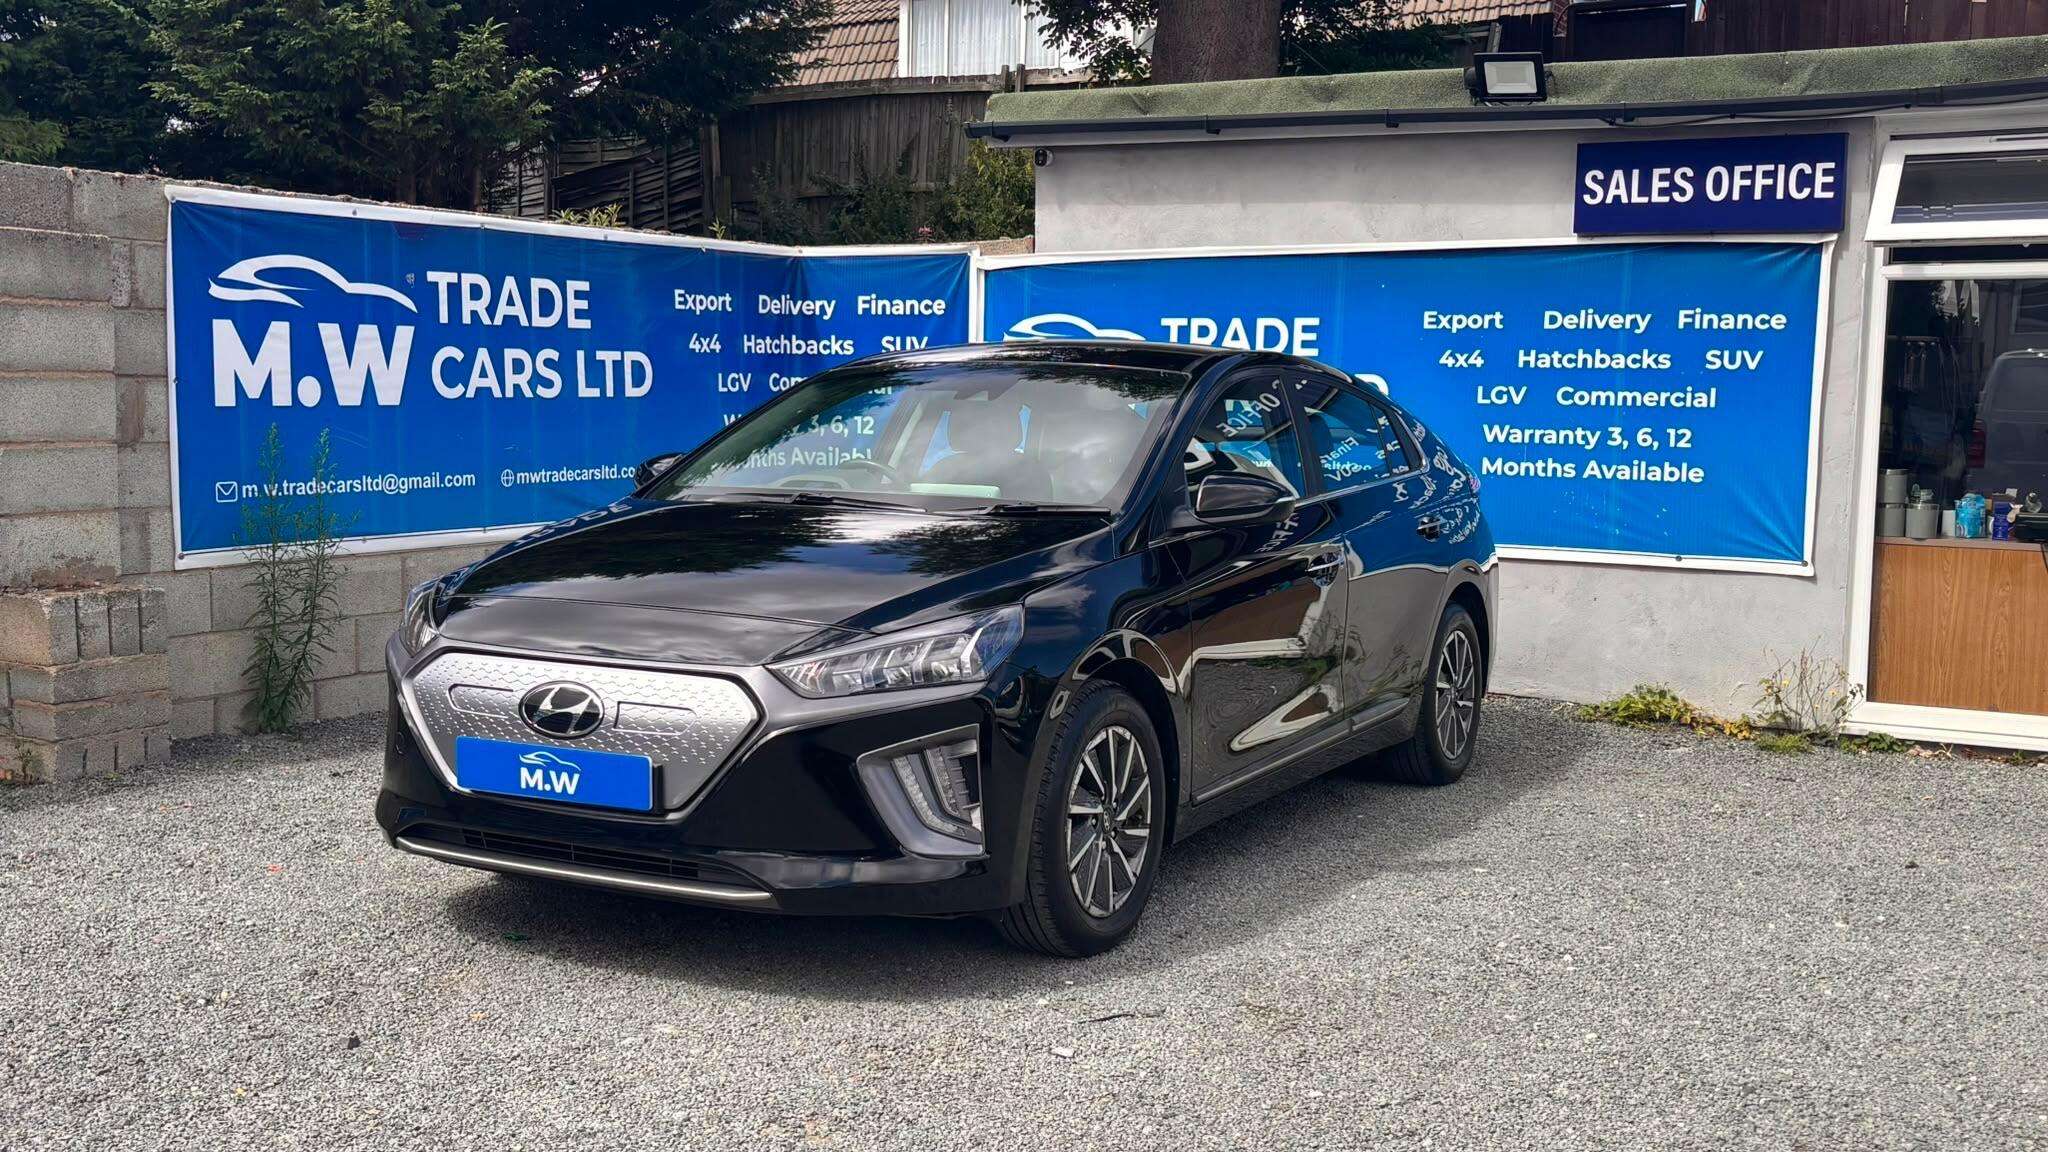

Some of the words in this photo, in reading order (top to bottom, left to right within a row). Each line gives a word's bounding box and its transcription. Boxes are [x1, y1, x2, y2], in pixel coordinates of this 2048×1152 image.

[1583, 167, 1694, 205] SALES
[1705, 162, 1836, 201] OFFICE
[426, 270, 592, 330] TRADE
[674, 289, 732, 315] Export
[758, 294, 836, 320] Delivery
[857, 293, 946, 316] Finance
[1423, 311, 1504, 333] Export
[1543, 308, 1651, 333] Delivery
[1678, 308, 1787, 330] Finance
[688, 333, 722, 354] 4x4
[743, 334, 855, 355] Hatchbacks
[881, 335, 928, 352] SUV
[1160, 317, 1320, 357] TRADE
[212, 318, 415, 408] M.W
[431, 345, 563, 399] CARS
[576, 350, 653, 398] LTD
[1438, 349, 1485, 368] 4x4
[1518, 348, 1672, 370] Hatchbacks
[1705, 350, 1764, 370] SUV
[718, 372, 752, 393] LGV
[1476, 385, 1527, 405] LGV
[1556, 386, 1717, 408] Commercial
[831, 416, 849, 437] 6,
[854, 416, 875, 435] 12
[1482, 424, 1601, 450] Warranty
[1607, 426, 1628, 450] 3,
[1636, 427, 1659, 450] 6,
[1666, 428, 1692, 448] 12
[516, 463, 636, 485] mwtradecarsltd.co
[1481, 458, 1576, 478] Months
[1582, 459, 1705, 483] Available
[242, 471, 476, 499] mw.tradecarsltd@gmail.com
[520, 767, 580, 795] M.W
